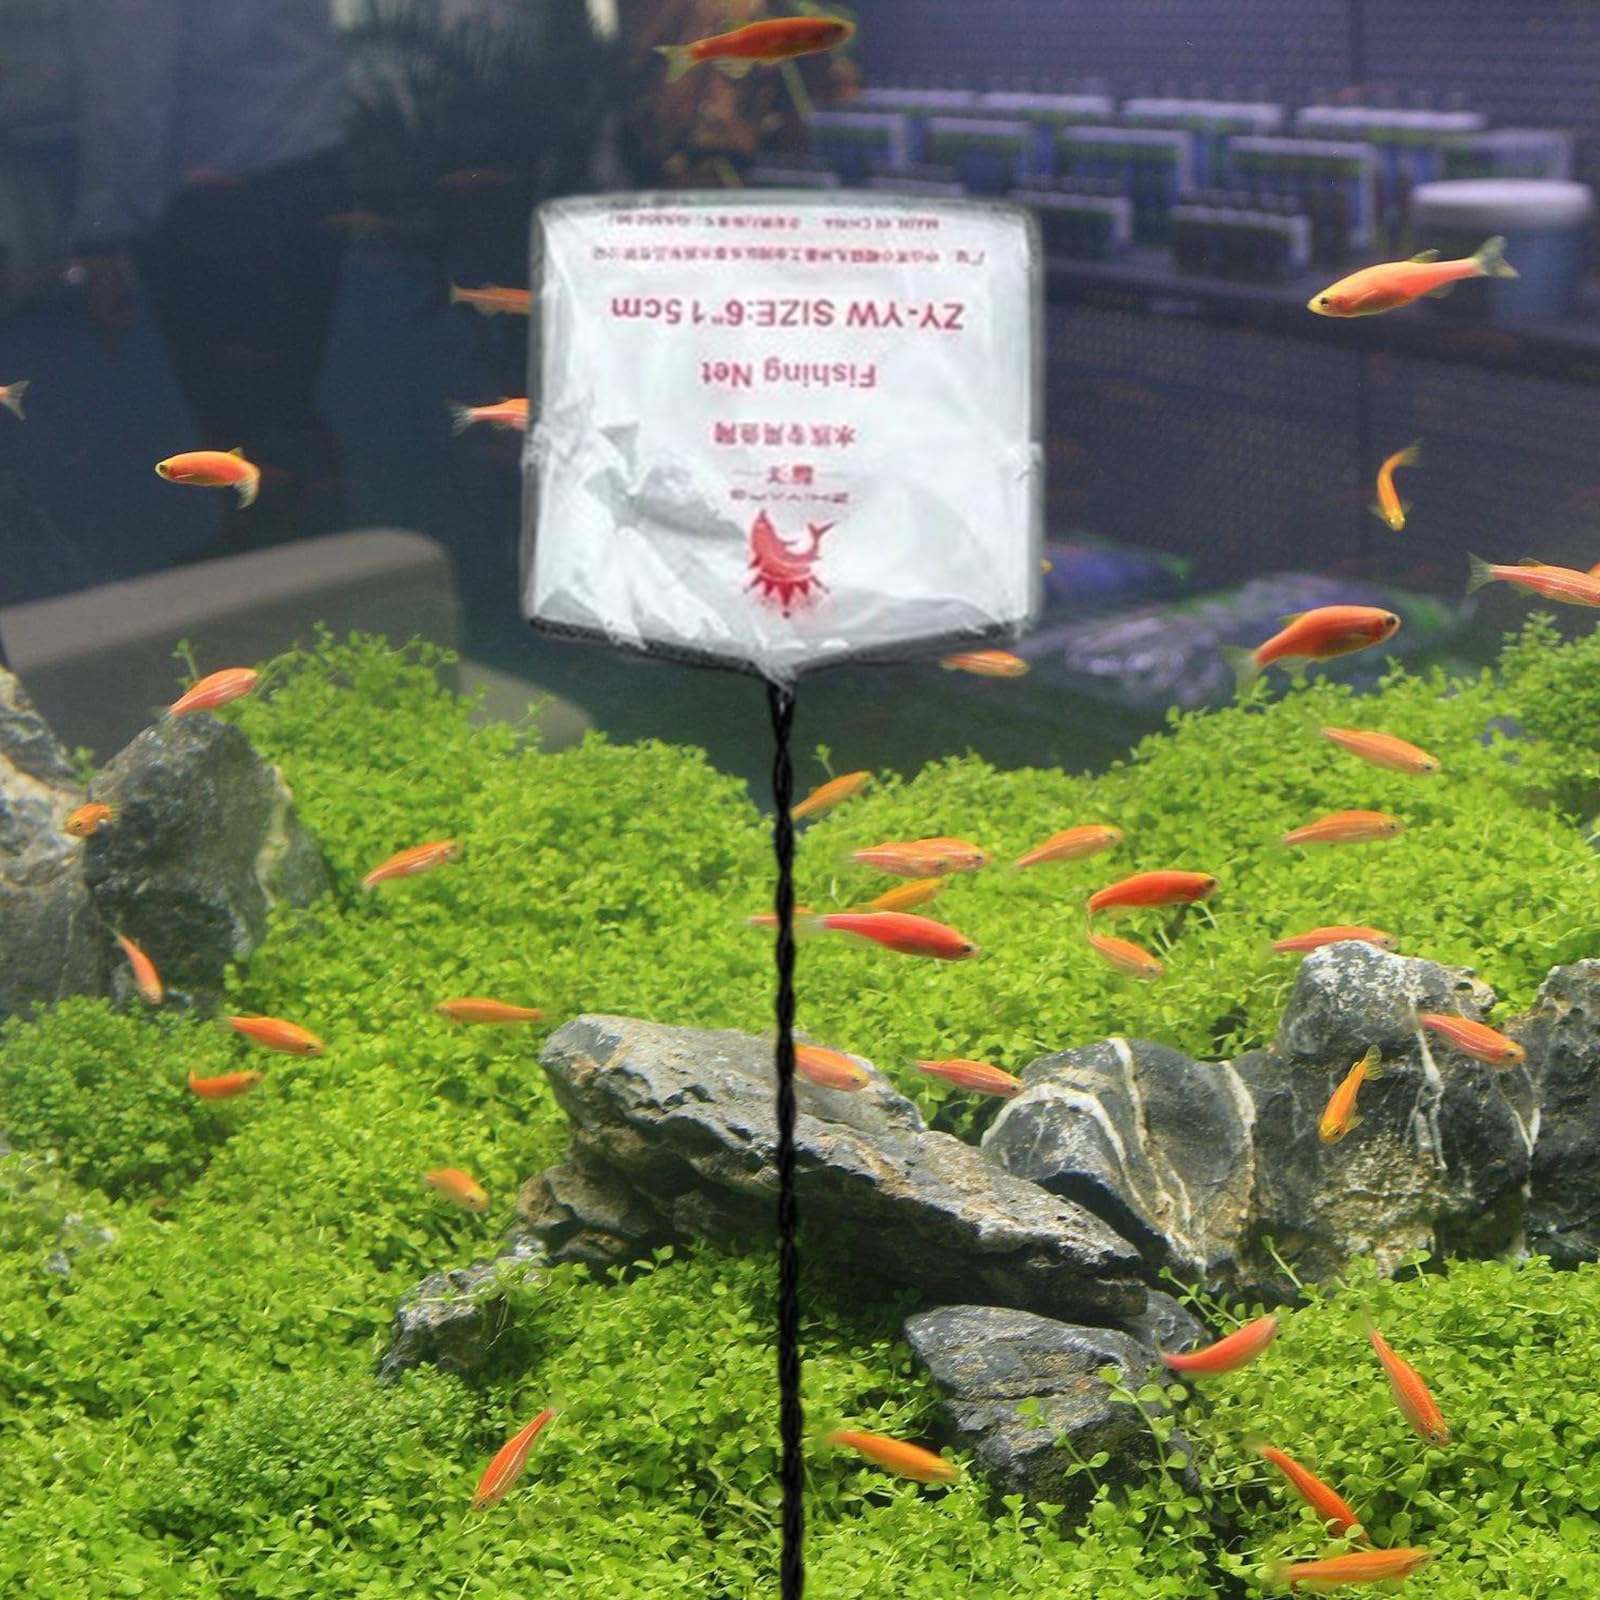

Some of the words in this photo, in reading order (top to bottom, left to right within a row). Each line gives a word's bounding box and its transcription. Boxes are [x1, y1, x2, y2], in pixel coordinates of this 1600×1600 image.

[846, 301, 965, 331] ZY-YW
[701, 361, 753, 387] Net
[763, 358, 877, 388] Fishing
